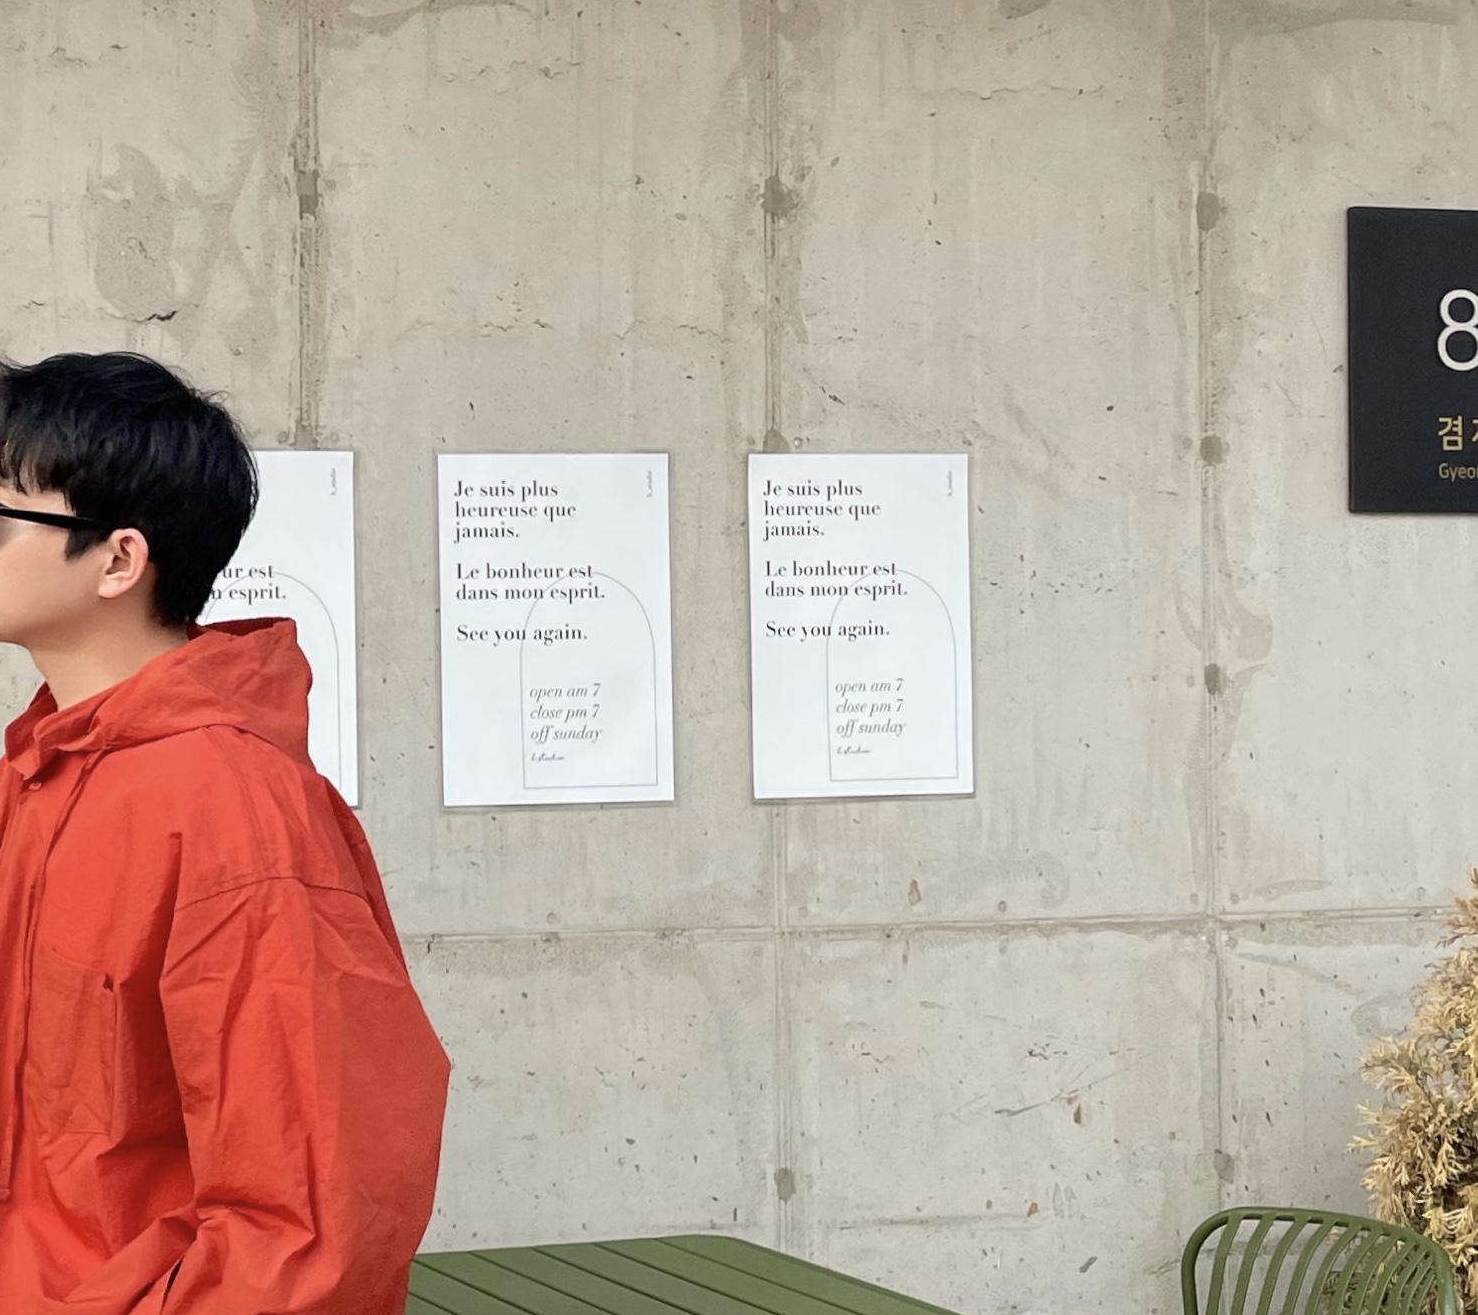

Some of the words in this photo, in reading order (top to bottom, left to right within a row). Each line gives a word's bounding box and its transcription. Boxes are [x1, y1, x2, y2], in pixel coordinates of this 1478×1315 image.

[1437, 288, 1478, 372] 8
[1438, 415, 1478, 451] 겸
[454, 481, 473, 496] Je
[480, 481, 514, 496] suis
[522, 480, 558, 502] plus
[763, 480, 781, 496] Je
[788, 480, 820, 496] suis
[827, 479, 862, 501] plus
[456, 500, 537, 517] heureuse
[544, 506, 576, 522] que
[765, 499, 842, 516] heureuse
[849, 505, 880, 521] que
[454, 522, 519, 544] jamais.
[763, 520, 824, 541] jamais.
[249, 565, 273, 579] est
[457, 563, 479, 579] Le
[487, 562, 563, 578] bonheur
[569, 566, 592, 578] est
[766, 561, 786, 576] Le
[793, 560, 868, 576] bonheur
[873, 563, 895, 575] est
[229, 583, 286, 605] esprit.
[456, 584, 498, 600] dans
[505, 589, 543, 600] mon
[550, 582, 605, 604] esprit.
[766, 581, 804, 596] dans
[811, 586, 848, 596] mon
[855, 580, 907, 601] esprit.
[457, 626, 488, 641] See
[493, 629, 525, 646] you
[533, 624, 587, 646] again.
[766, 621, 795, 637] See
[800, 626, 831, 642] you
[838, 620, 889, 641] again.
[530, 686, 563, 702] open
[566, 687, 588, 698] am
[592, 683, 600, 697] 7
[835, 682, 867, 697] open
[870, 682, 892, 692] am
[896, 678, 904, 692] 7
[530, 705, 562, 720] close
[565, 708, 588, 723] pm
[592, 704, 600, 718] 7
[835, 700, 867, 715] close
[870, 703, 892, 717] pm
[896, 699, 904, 712] 7
[530, 725, 552, 745] off
[553, 725, 601, 742] sunday
[836, 719, 857, 738] off
[858, 720, 904, 737] sunday
